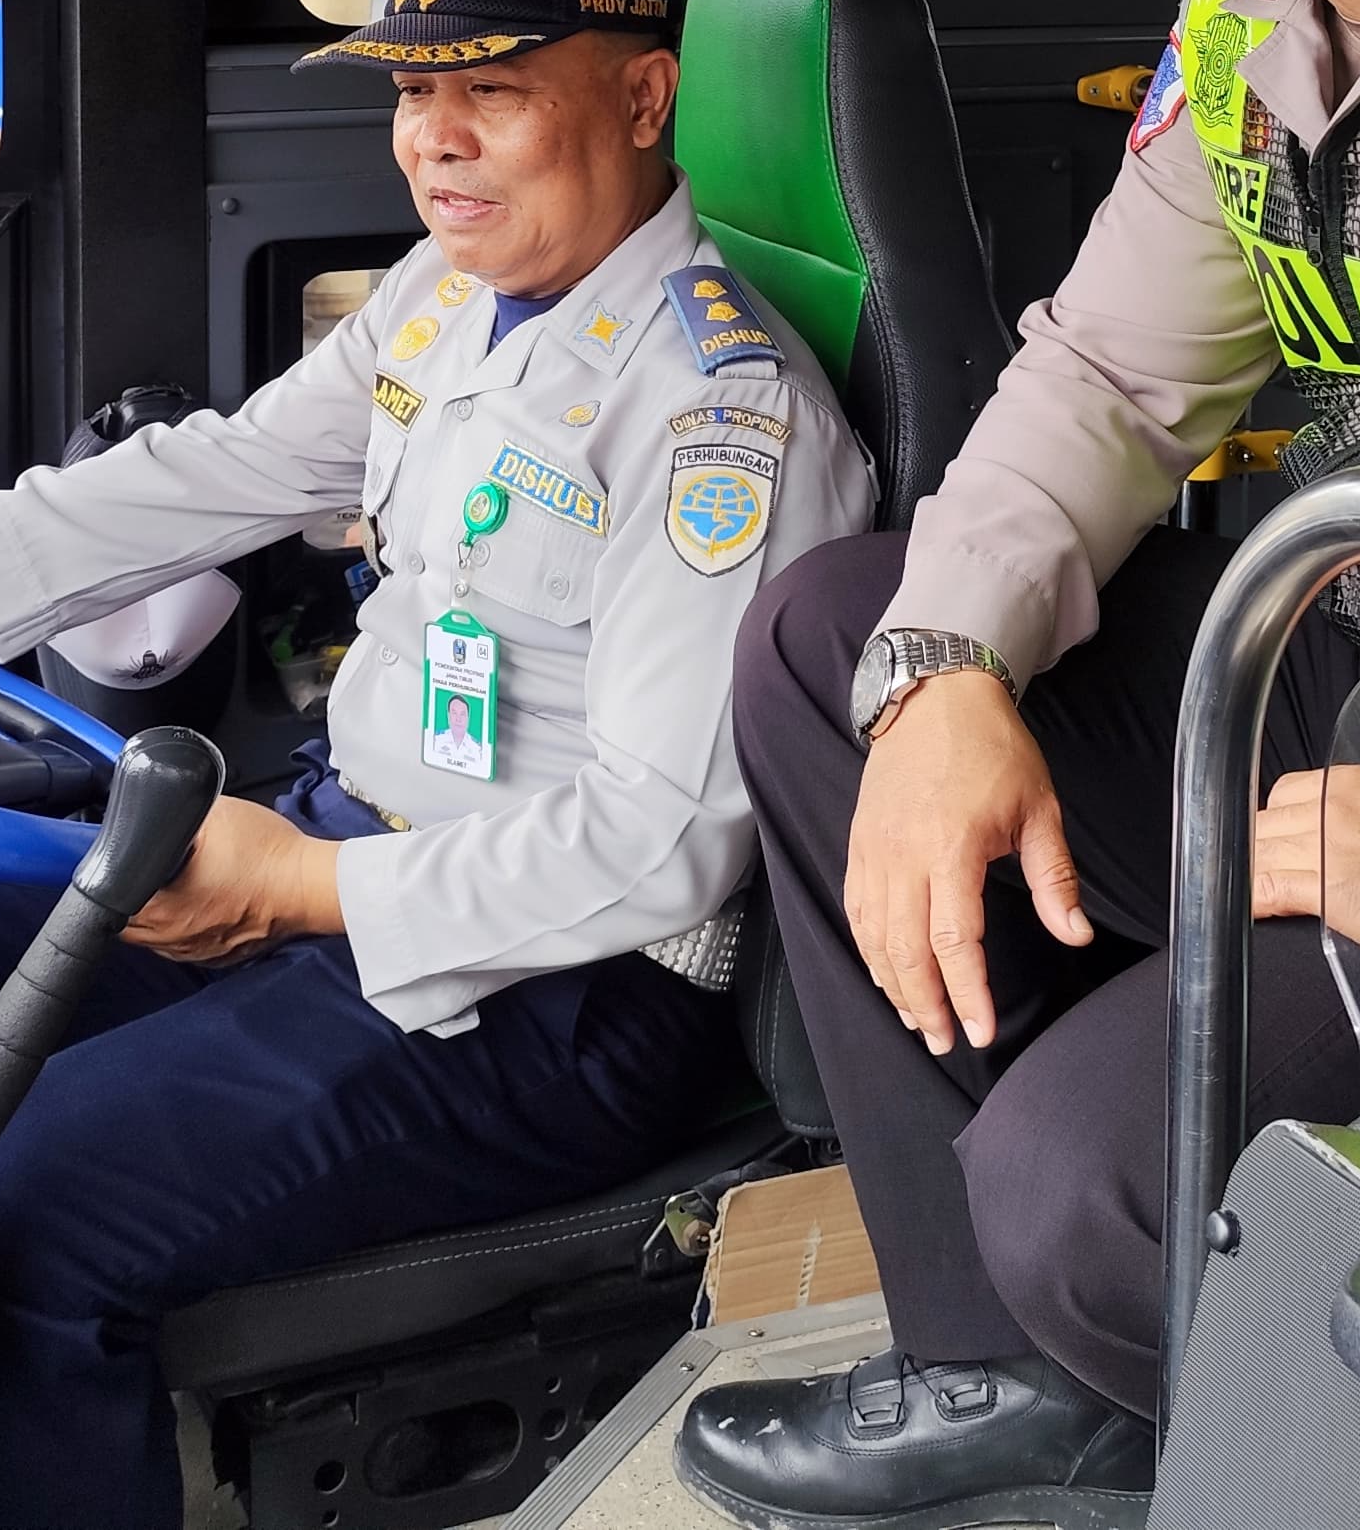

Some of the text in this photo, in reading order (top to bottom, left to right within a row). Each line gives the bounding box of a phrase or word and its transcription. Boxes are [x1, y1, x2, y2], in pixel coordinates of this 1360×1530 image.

[671, 409, 787, 440] DINAS PROPINSI
[677, 448, 774, 474] PERHUBUNGAN
[498, 452, 594, 520] DISHUB
